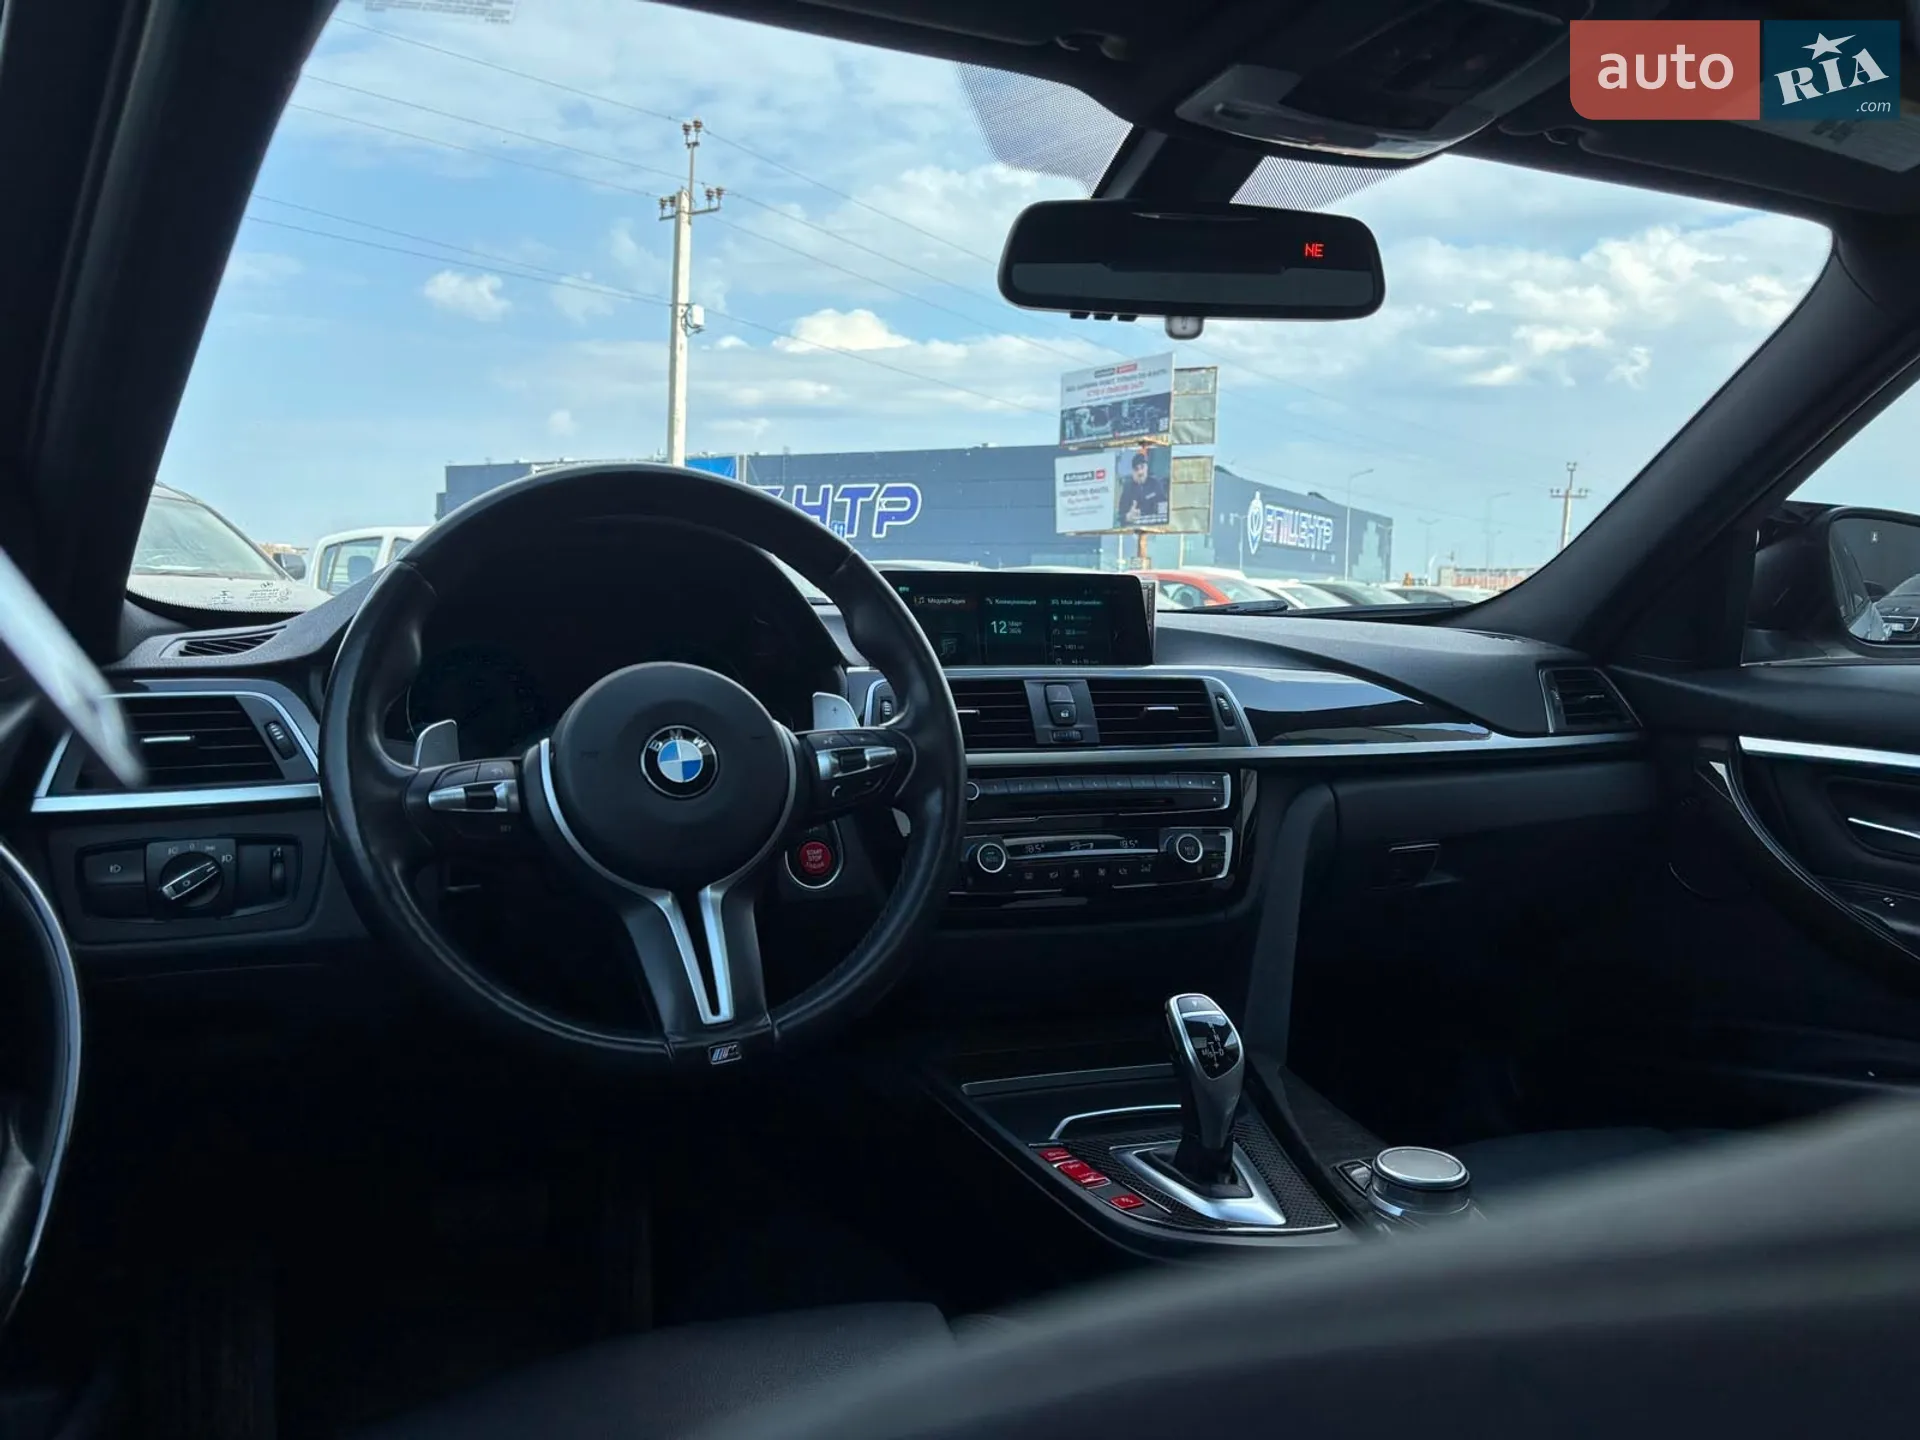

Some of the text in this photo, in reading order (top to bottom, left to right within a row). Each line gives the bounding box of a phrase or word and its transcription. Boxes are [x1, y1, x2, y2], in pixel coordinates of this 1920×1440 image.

[1304, 242, 1325, 257] NE
[990, 620, 1008, 634] 12
[648, 729, 708, 753] BMW
